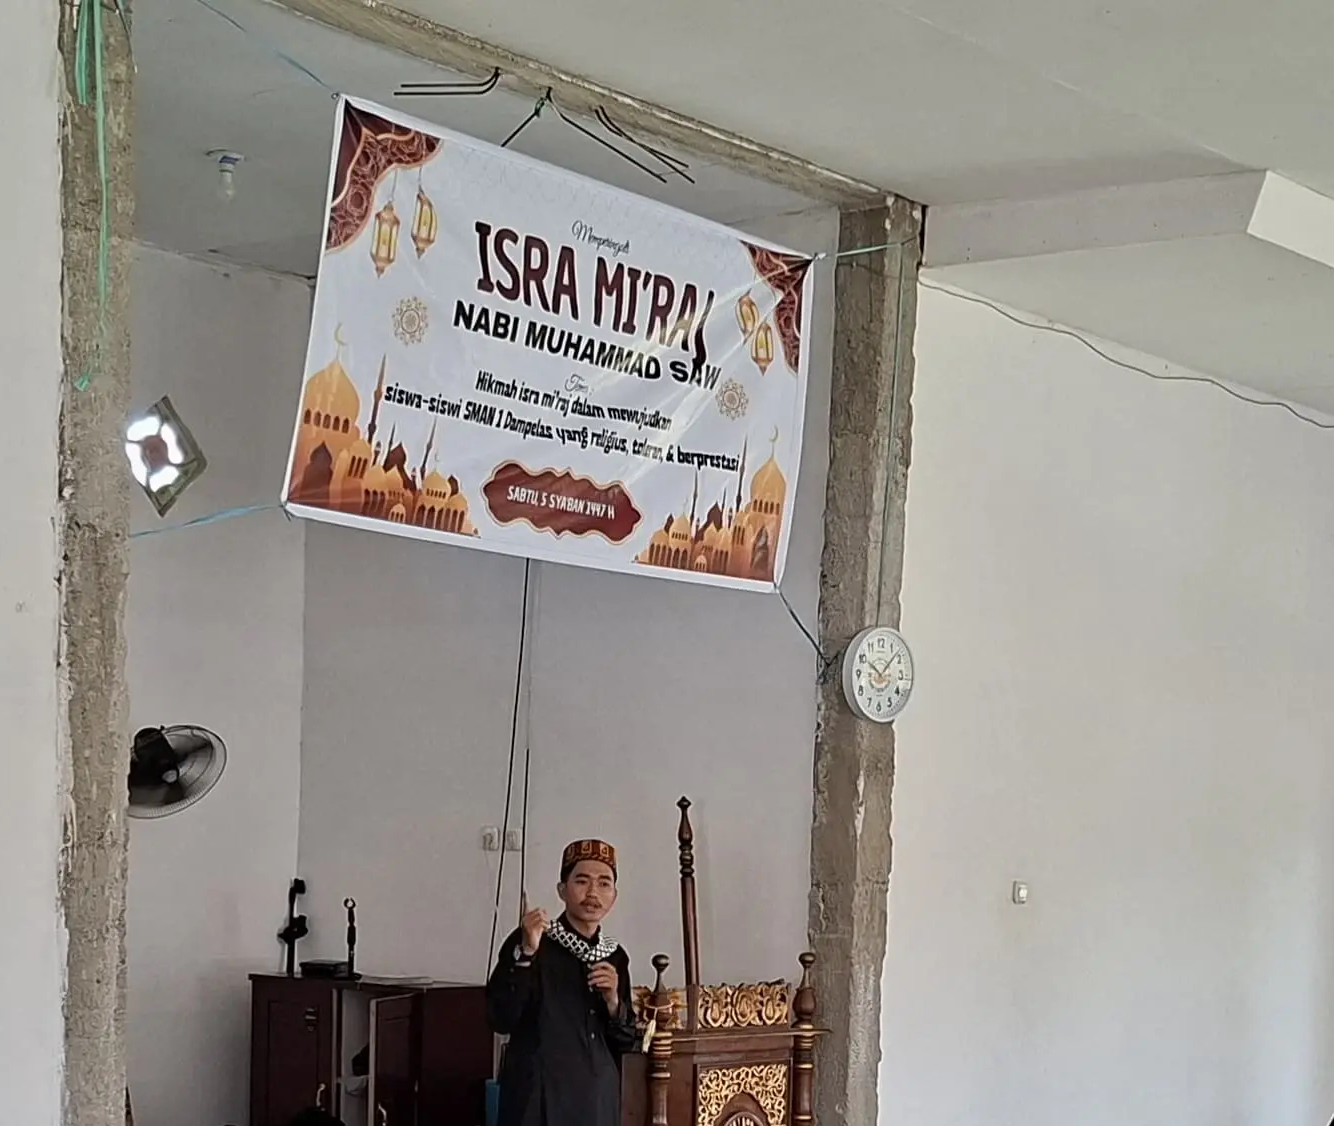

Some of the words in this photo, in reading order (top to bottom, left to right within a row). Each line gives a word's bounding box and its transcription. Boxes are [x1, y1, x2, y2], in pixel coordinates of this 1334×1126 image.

[475, 221, 578, 320] ISRA
[454, 301, 519, 342] NABI
[525, 321, 661, 380] MUHAMMAD
[669, 360, 722, 390] SAW
[475, 370, 517, 400] Hikmah
[519, 382, 540, 405] isra
[540, 389, 570, 417] mi'raj
[570, 395, 606, 418] dalam
[607, 407, 673, 430] mewujudkan
[384, 383, 463, 418] siswa-siswi
[463, 401, 496, 428] SMAN
[495, 409, 503, 428] 1
[503, 411, 554, 440] Dampelas
[554, 426, 588, 449] yang
[665, 444, 675, 462] &
[677, 446, 740, 471] berprestasi
[540, 492, 547, 507] 5
[548, 493, 586, 515] SYABAN
[606, 504, 616, 521] H
[856, 669, 861, 680] 9
[858, 685, 864, 696] 8
[895, 686, 900, 696] 4
[867, 697, 872, 708] 7
[876, 701, 881, 712] 6
[887, 697, 893, 708] 5
